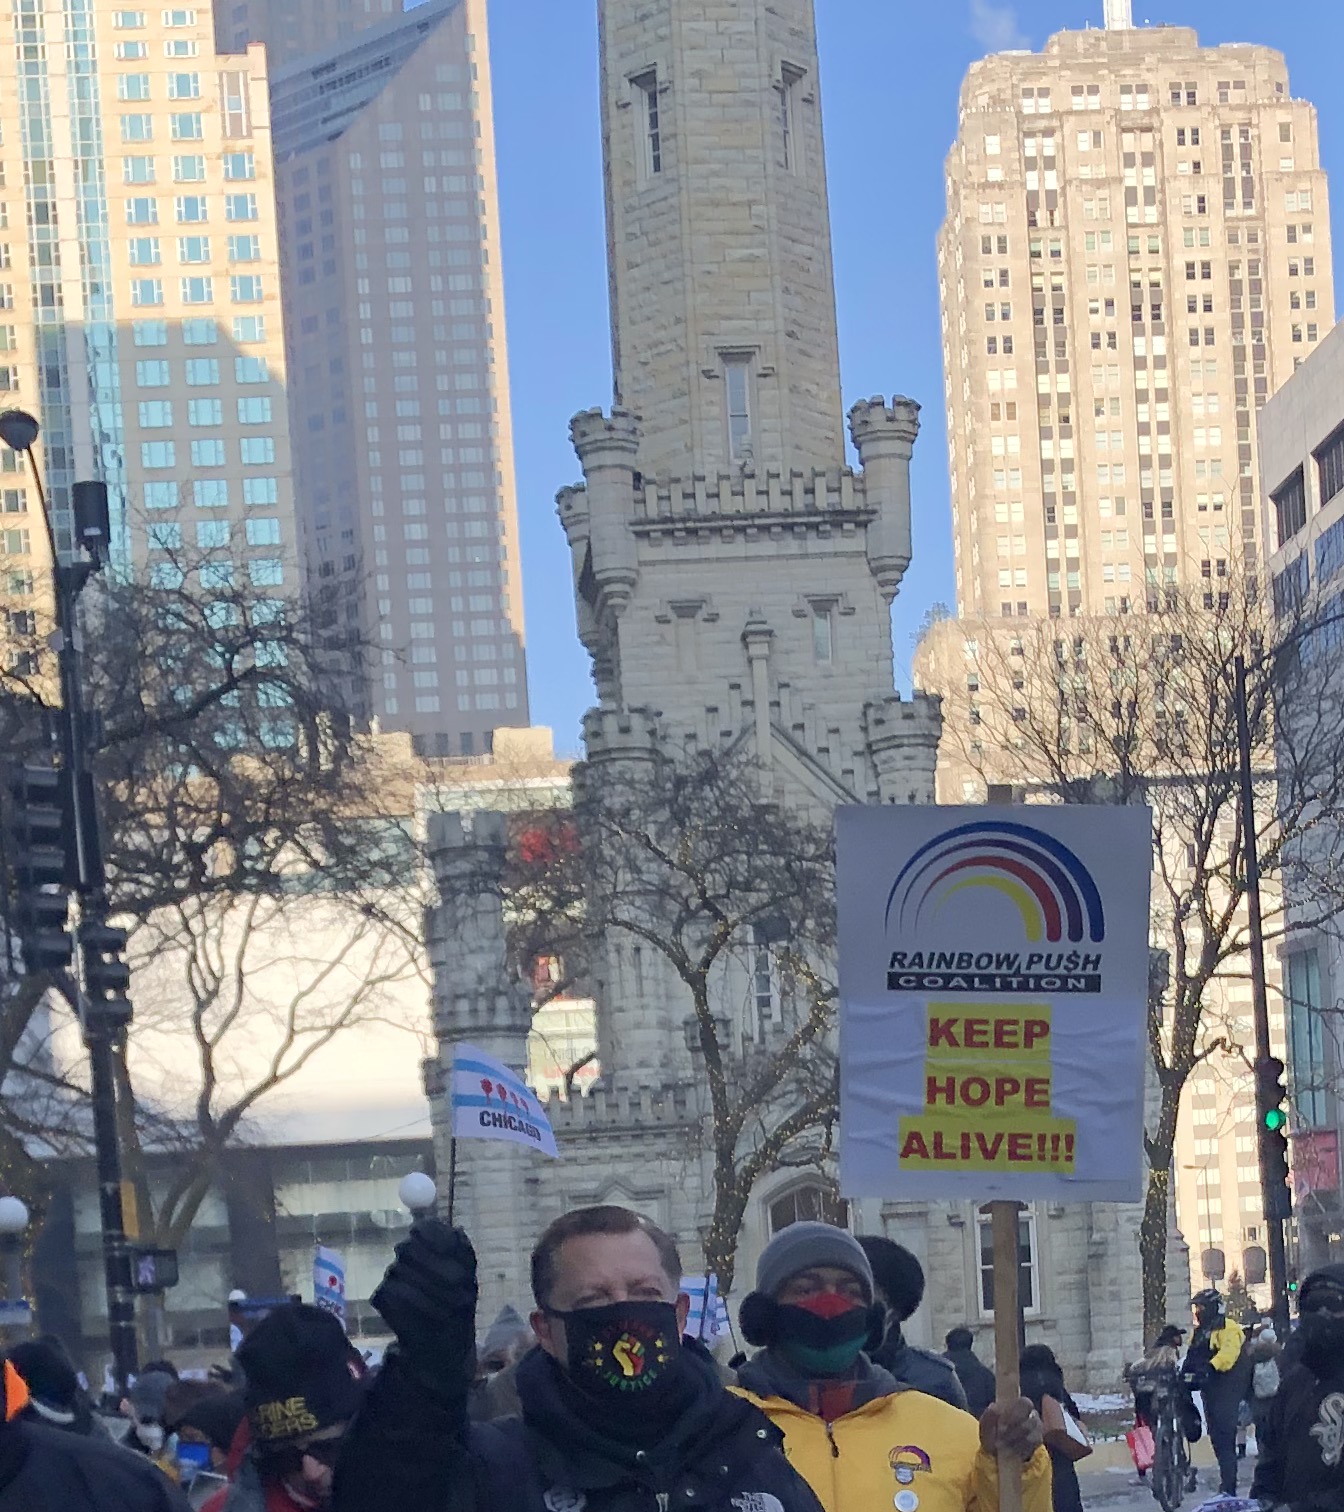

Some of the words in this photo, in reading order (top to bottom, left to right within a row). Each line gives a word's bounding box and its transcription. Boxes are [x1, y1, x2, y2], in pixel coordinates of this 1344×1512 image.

[898, 976, 1086, 989] COALITION
[928, 1017, 1050, 1050] KEEP
[926, 1076, 1051, 1108] HOPE
[479, 1110, 542, 1142] CHICAGO
[899, 1130, 1075, 1163] ALIVE!!!
